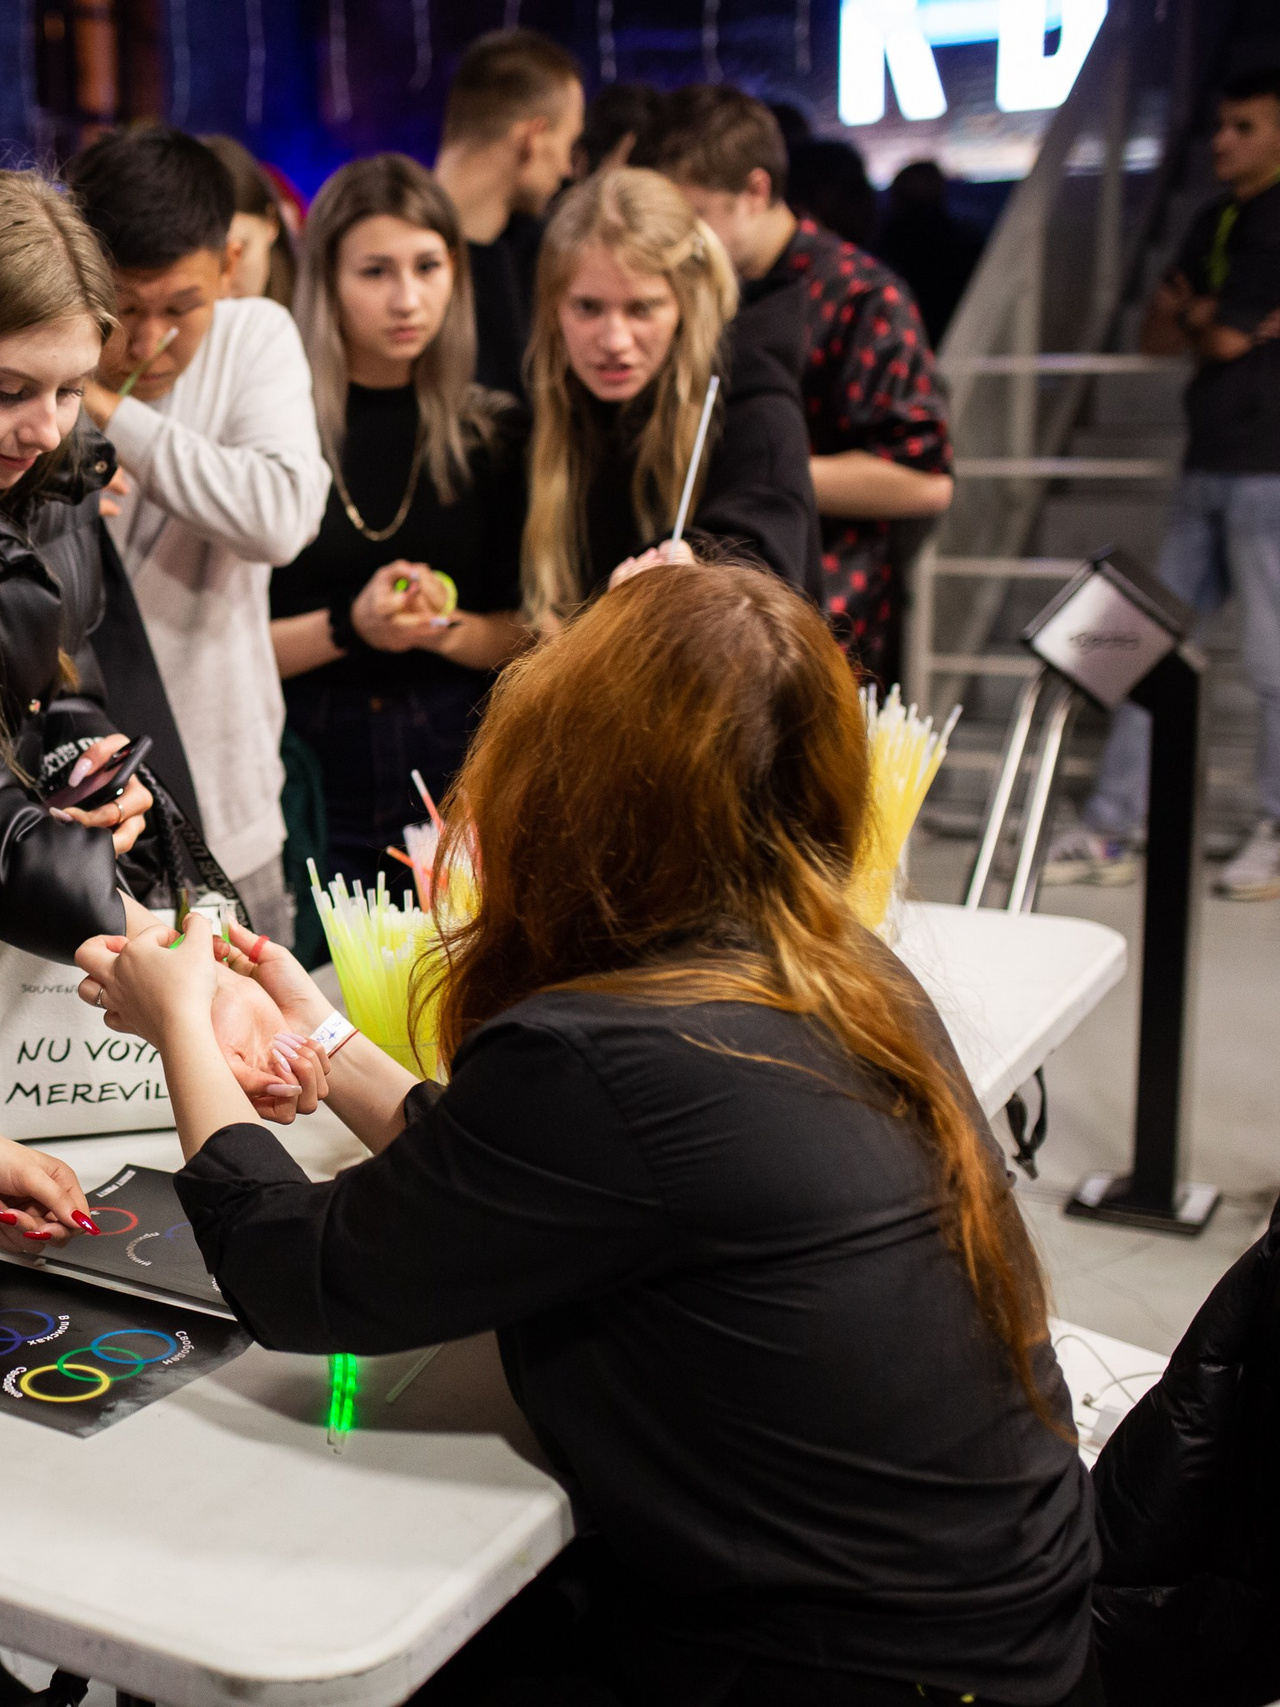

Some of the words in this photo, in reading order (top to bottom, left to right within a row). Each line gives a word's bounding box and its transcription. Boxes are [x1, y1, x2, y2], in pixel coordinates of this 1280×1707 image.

[21, 983, 77, 995] SOUVEN
[17, 1037, 71, 1064] NU
[27, 1321, 70, 1346] поисках
[161, 1330, 195, 1365] Свободен
